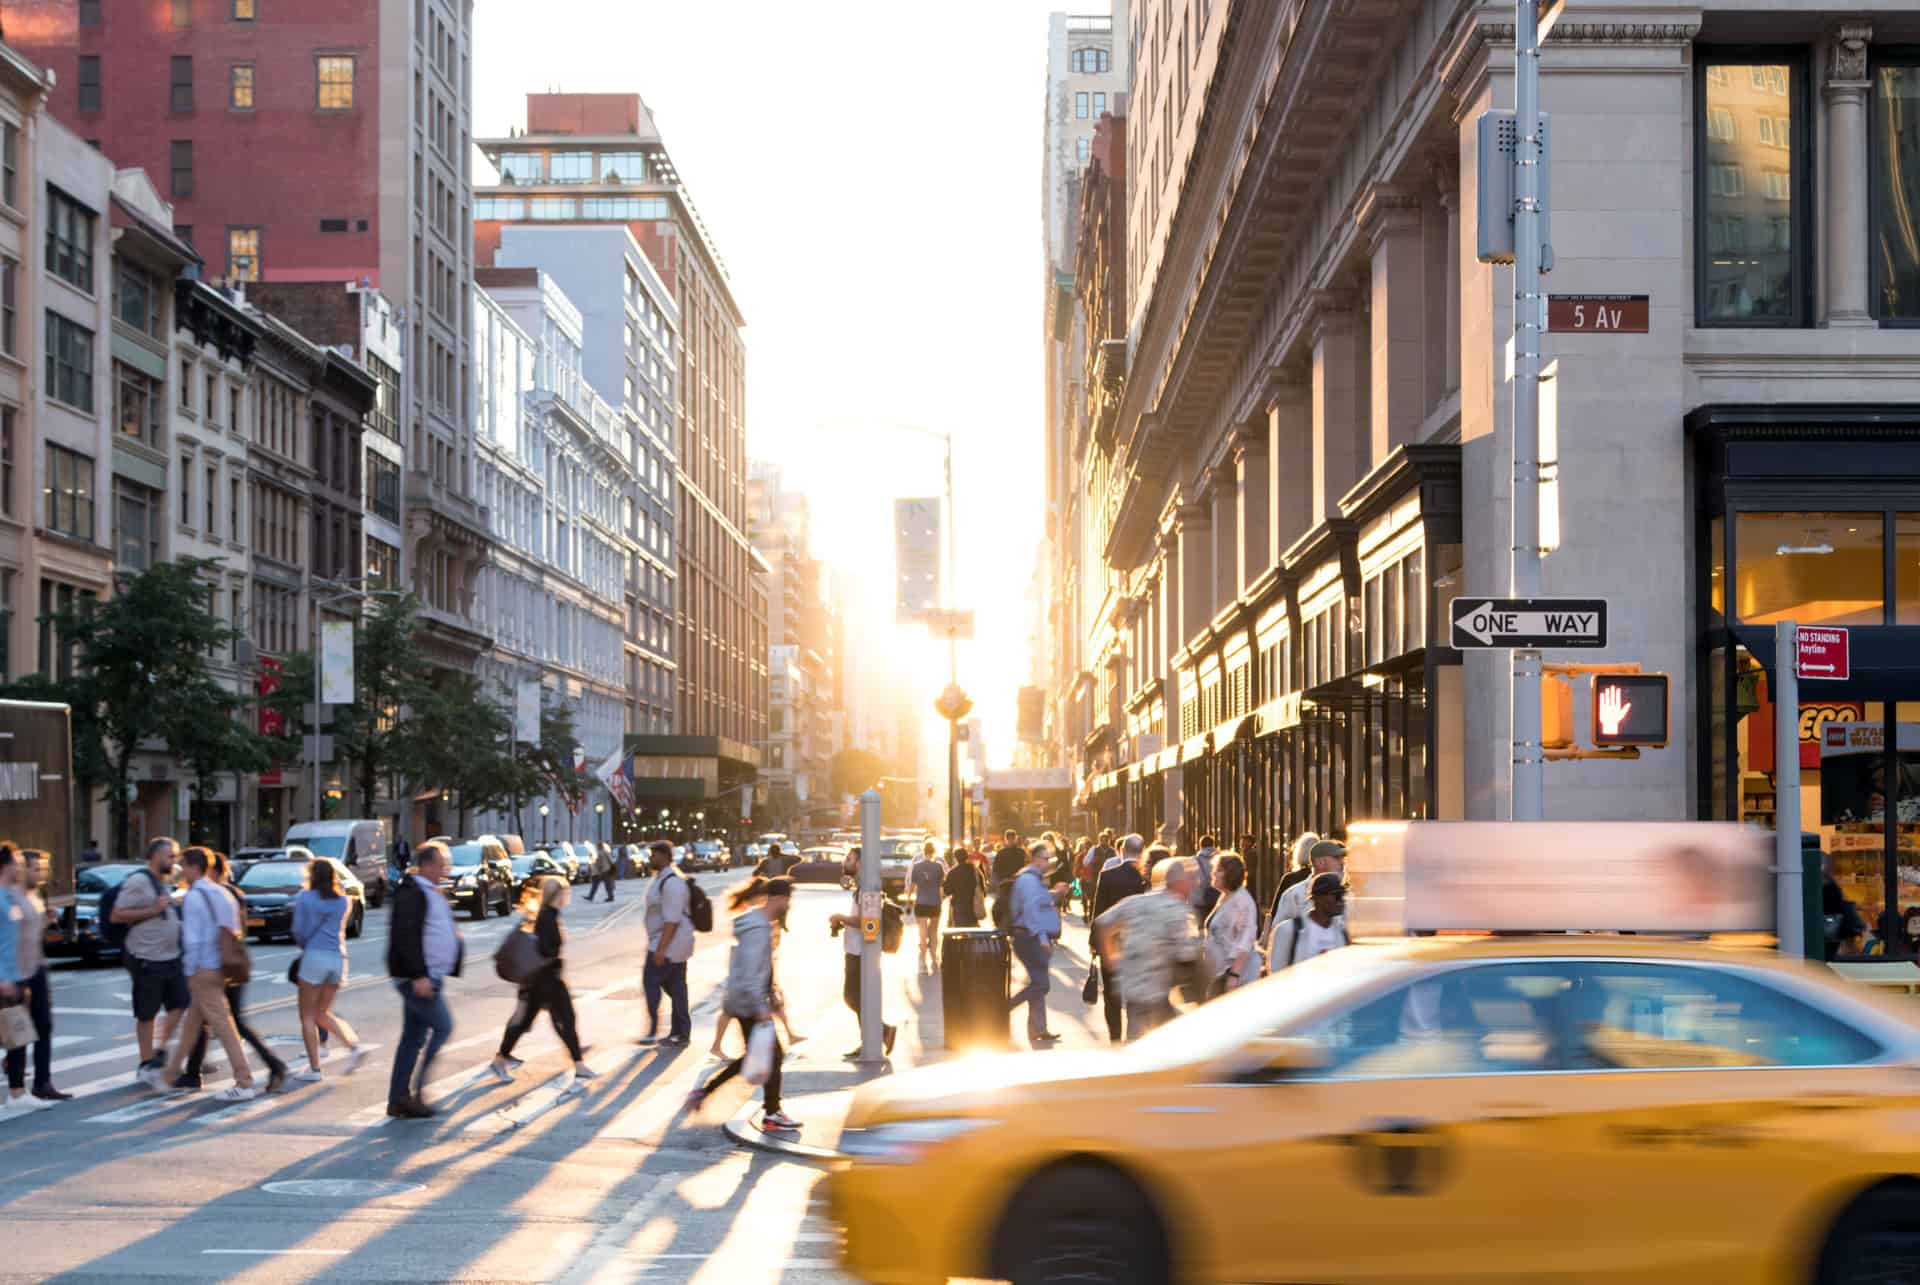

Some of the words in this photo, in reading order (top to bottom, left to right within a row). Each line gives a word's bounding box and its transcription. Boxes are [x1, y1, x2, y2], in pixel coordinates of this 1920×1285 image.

[1574, 305, 1585, 328] 5
[1595, 305, 1623, 329] Av
[1472, 614, 1518, 633] ONE
[1544, 614, 1593, 633] WAY
[1799, 631, 1809, 642] NO
[1810, 632, 1841, 643] STANDING
[1800, 642, 1826, 655] Anytime
[1798, 708, 1857, 740] EG
